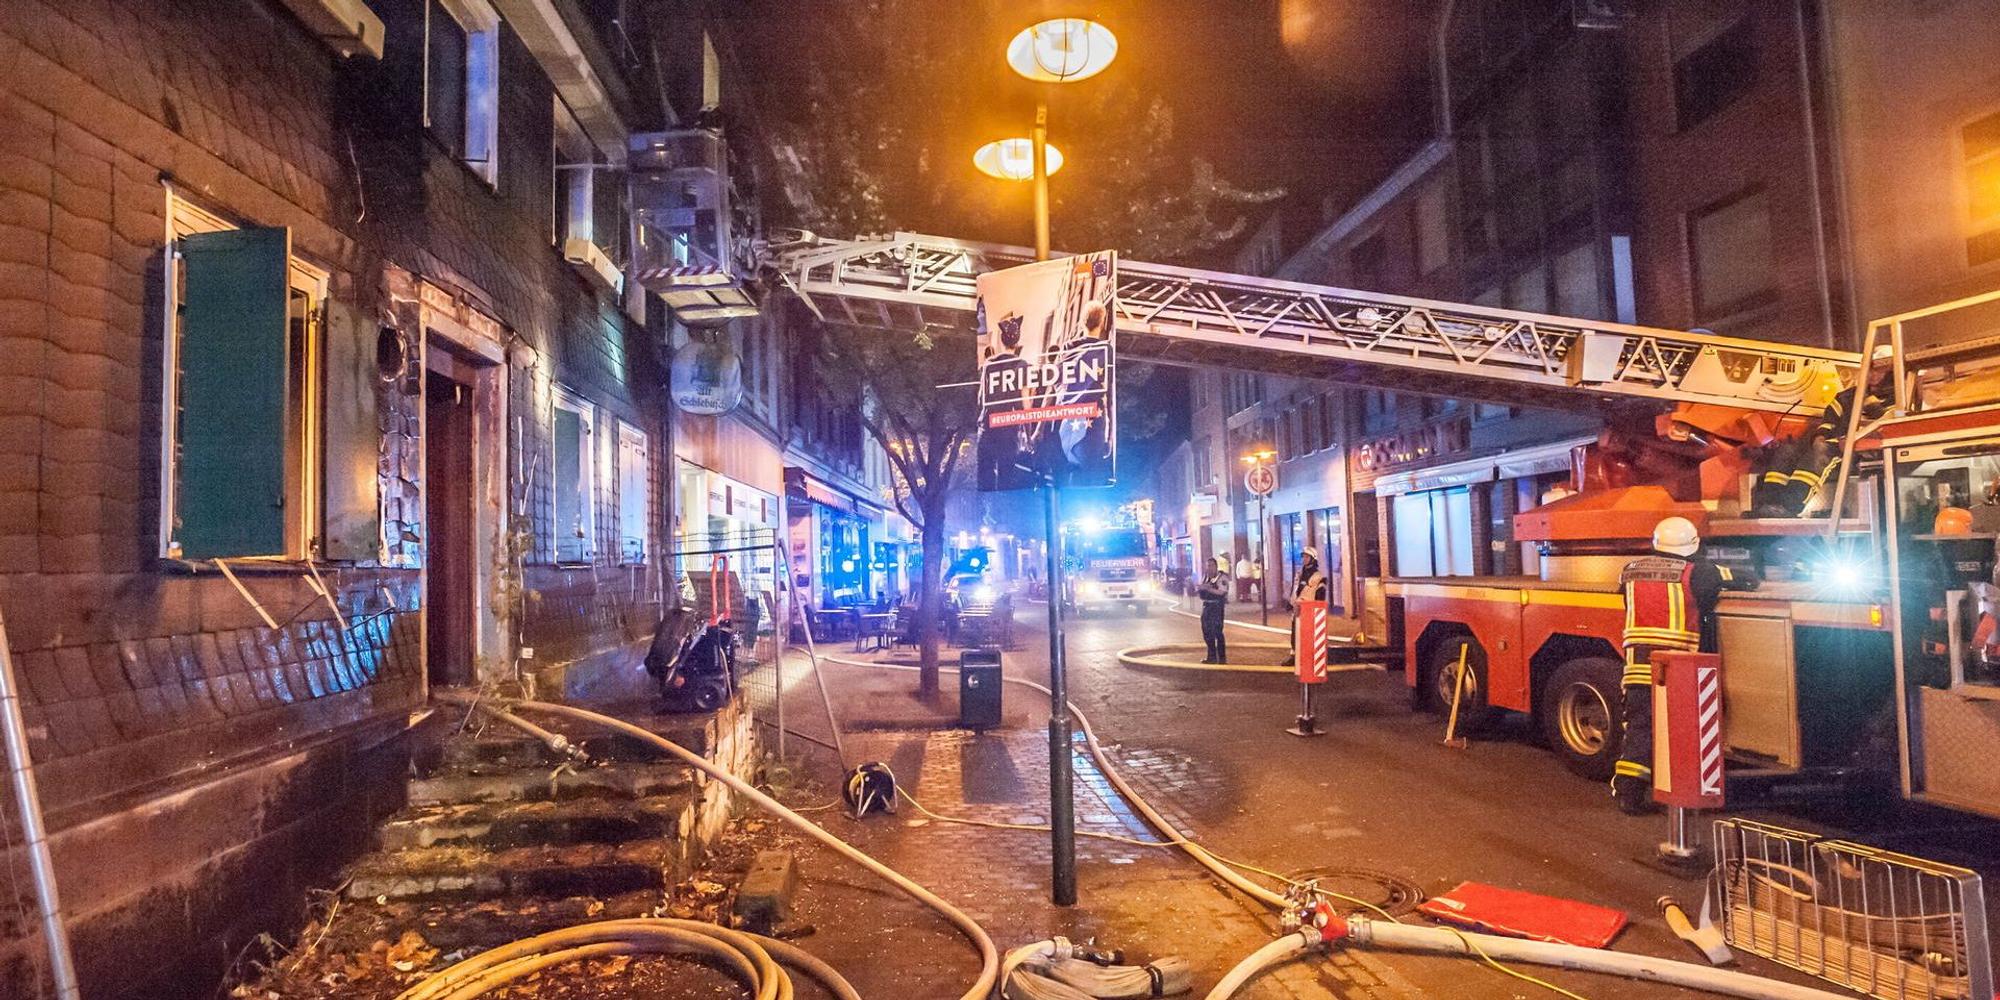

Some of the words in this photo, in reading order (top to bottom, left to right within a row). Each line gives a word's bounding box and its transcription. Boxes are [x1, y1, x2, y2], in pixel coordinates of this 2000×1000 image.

[989, 358, 1098, 394] FRIEDEN
[991, 406, 1095, 424] #EUROPAISTDIEANTWORT
[1091, 559, 1145, 568] FEUERWEHR
